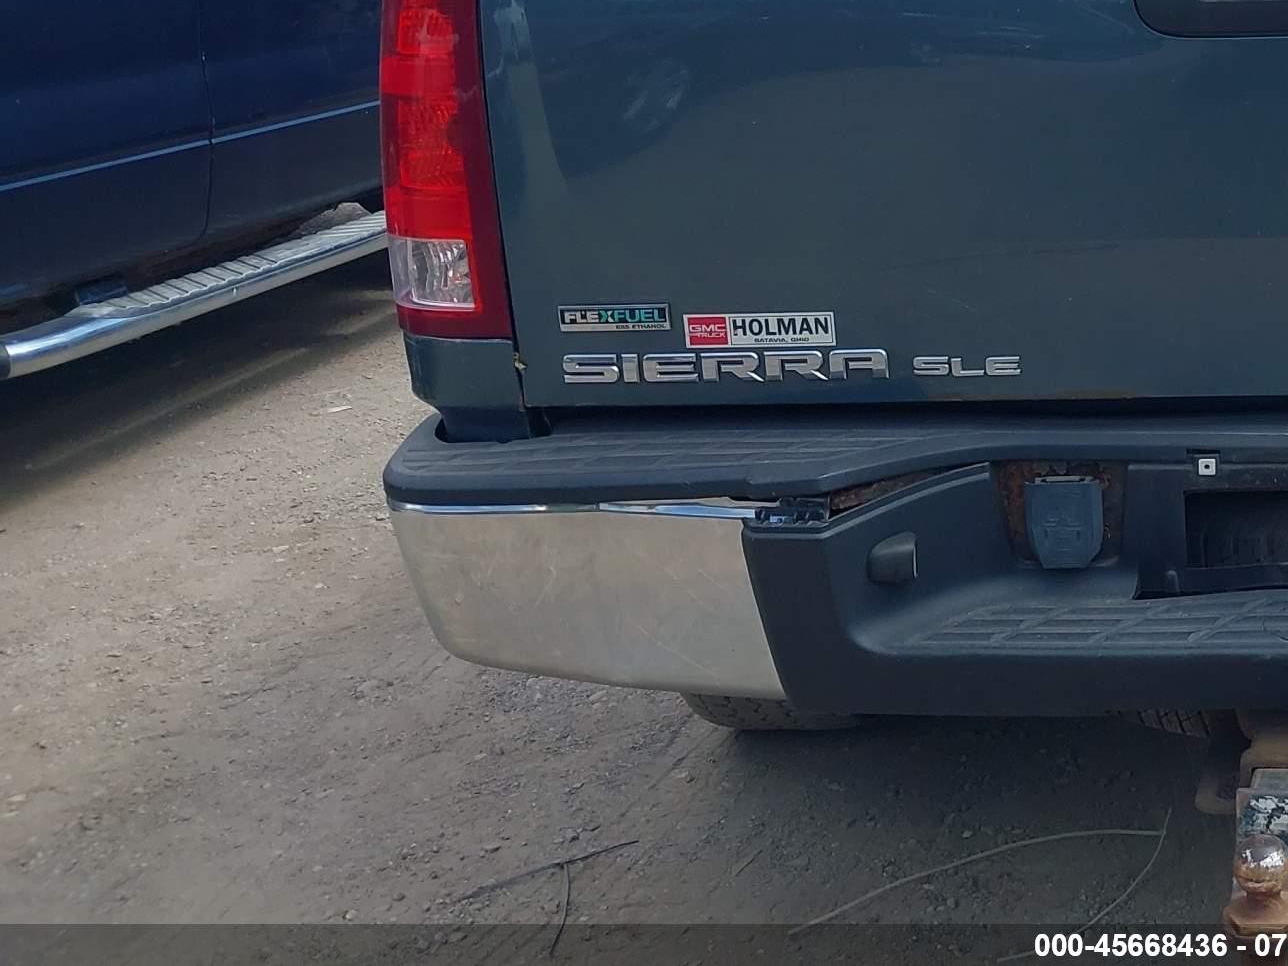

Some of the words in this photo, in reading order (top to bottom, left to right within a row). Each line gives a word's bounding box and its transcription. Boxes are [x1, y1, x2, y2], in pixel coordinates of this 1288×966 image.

[564, 308, 666, 324] FLEXFUEL
[632, 322, 667, 330] ETHANOL
[689, 323, 727, 333] GMC
[732, 316, 829, 337] HOLMAN
[562, 348, 890, 384] SIERRA
[912, 355, 1023, 378] SLE
